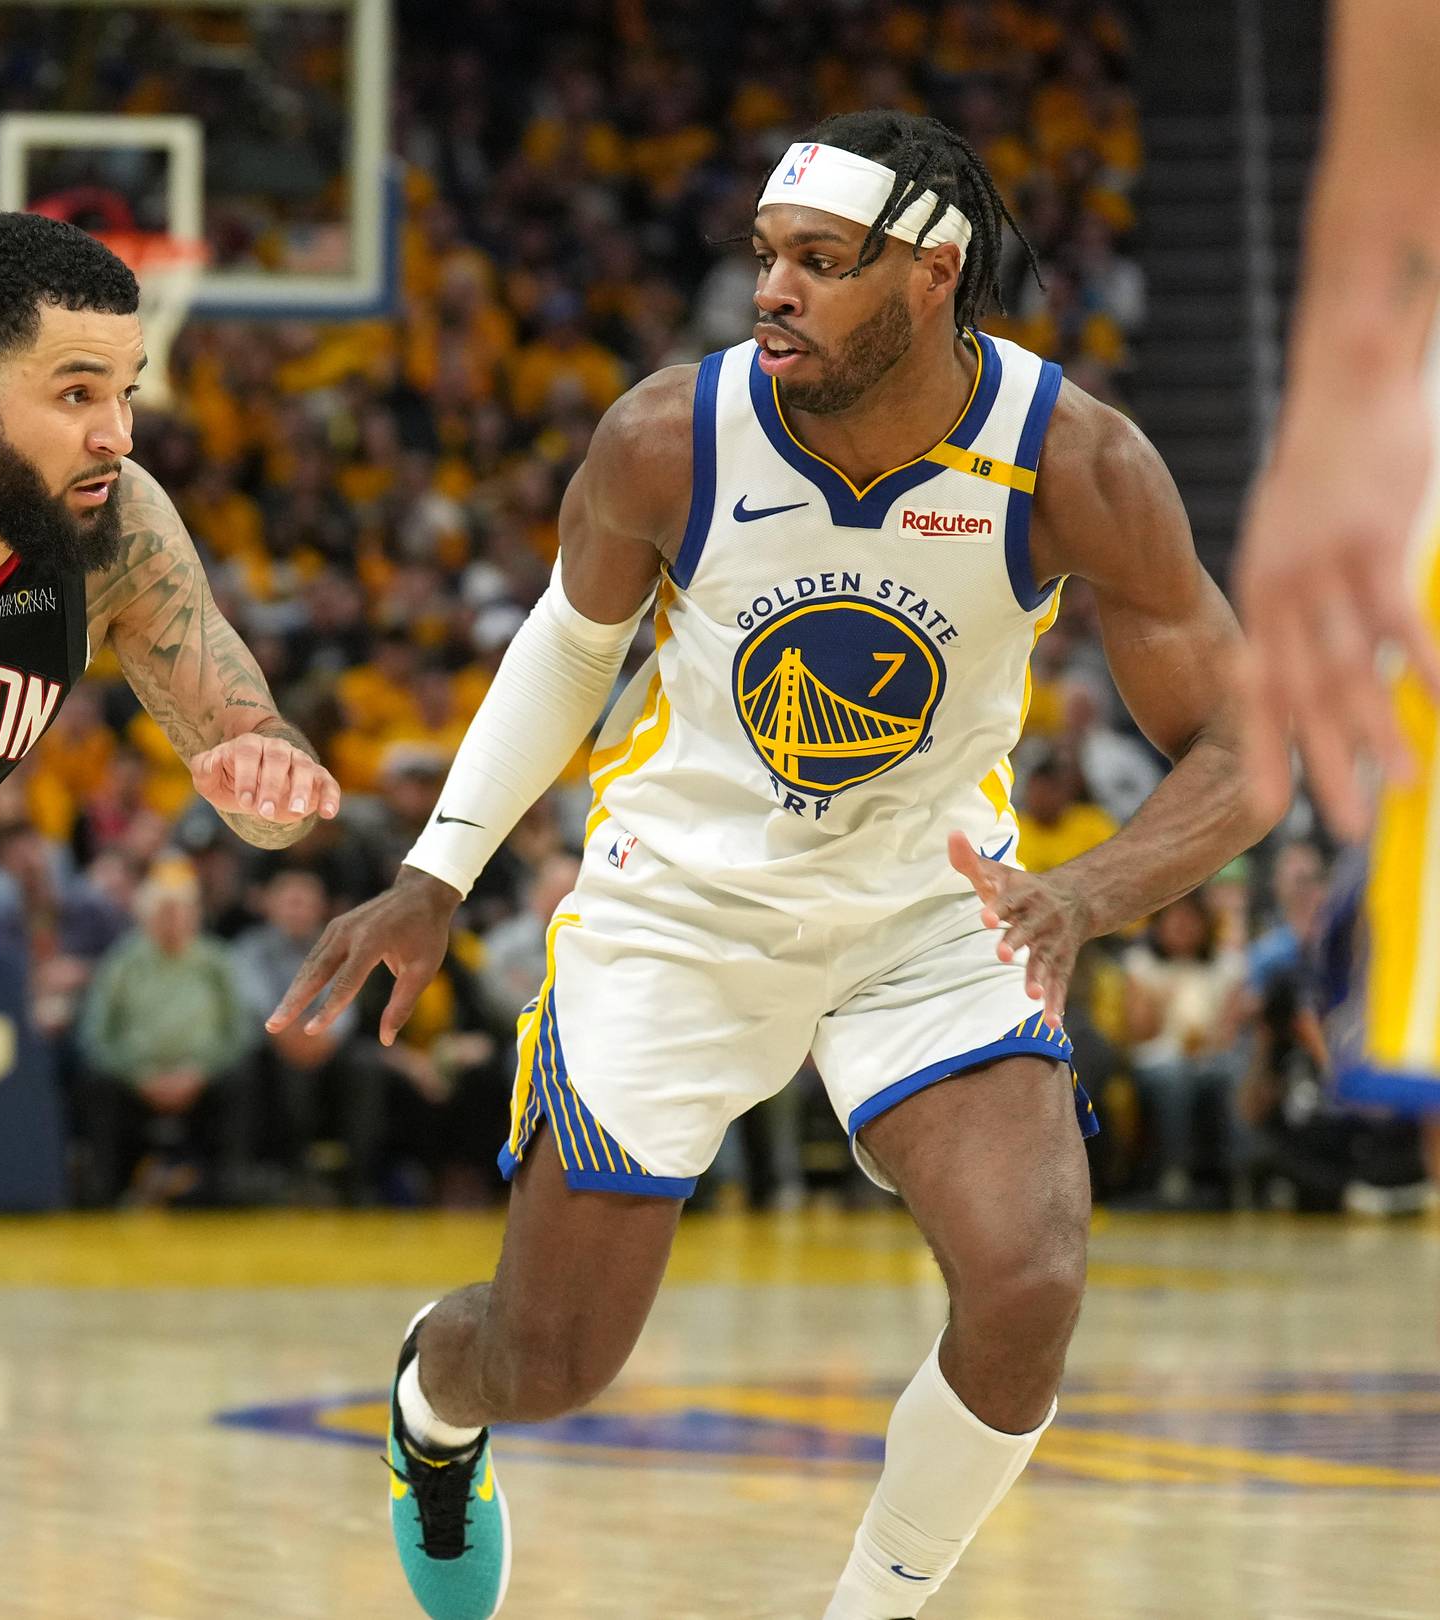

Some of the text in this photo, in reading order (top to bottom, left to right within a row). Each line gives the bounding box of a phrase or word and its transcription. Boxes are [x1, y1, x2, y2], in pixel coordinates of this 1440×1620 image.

[970, 457, 993, 477] 16
[902, 510, 992, 535] Rakuten
[736, 572, 959, 645] GOLDEN STATE
[868, 652, 906, 698] 7
